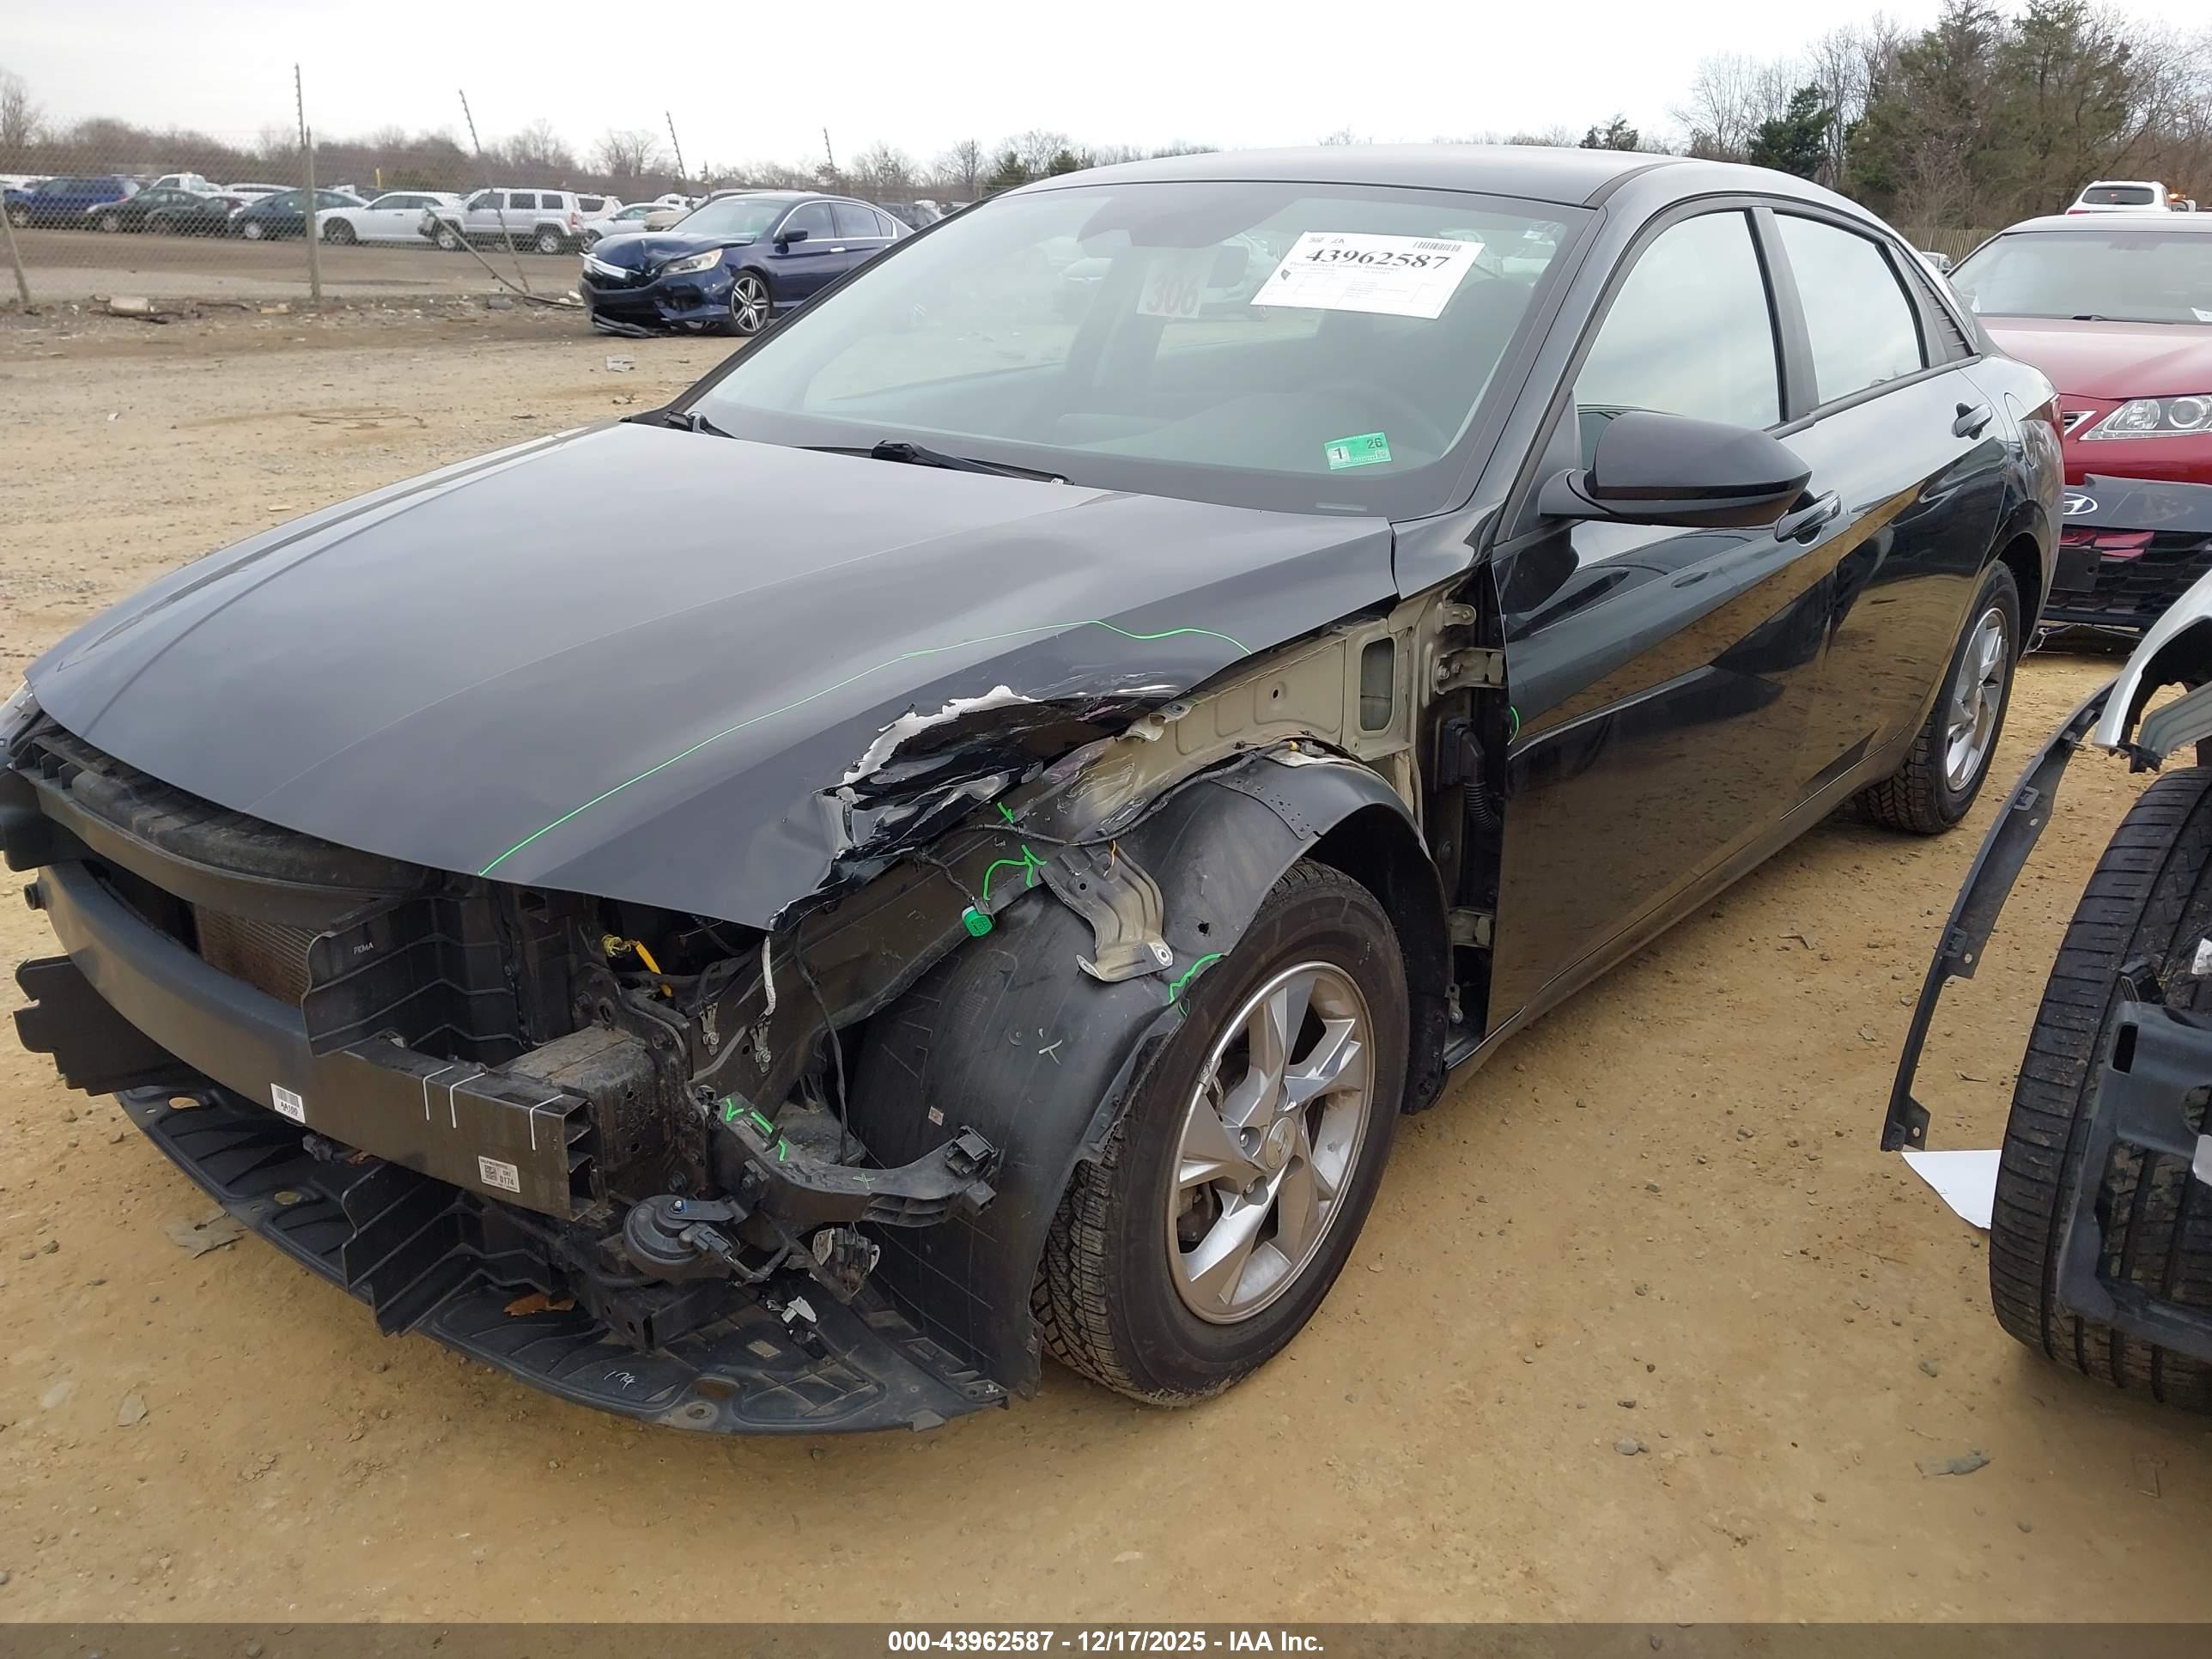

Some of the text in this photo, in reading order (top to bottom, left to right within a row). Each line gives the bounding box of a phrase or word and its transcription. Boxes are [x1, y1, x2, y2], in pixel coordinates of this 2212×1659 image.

[1304, 248, 1451, 270] 43962587
[1146, 275, 1200, 315] 306
[1367, 438, 1382, 449] 26
[1334, 447, 1343, 459] 1
